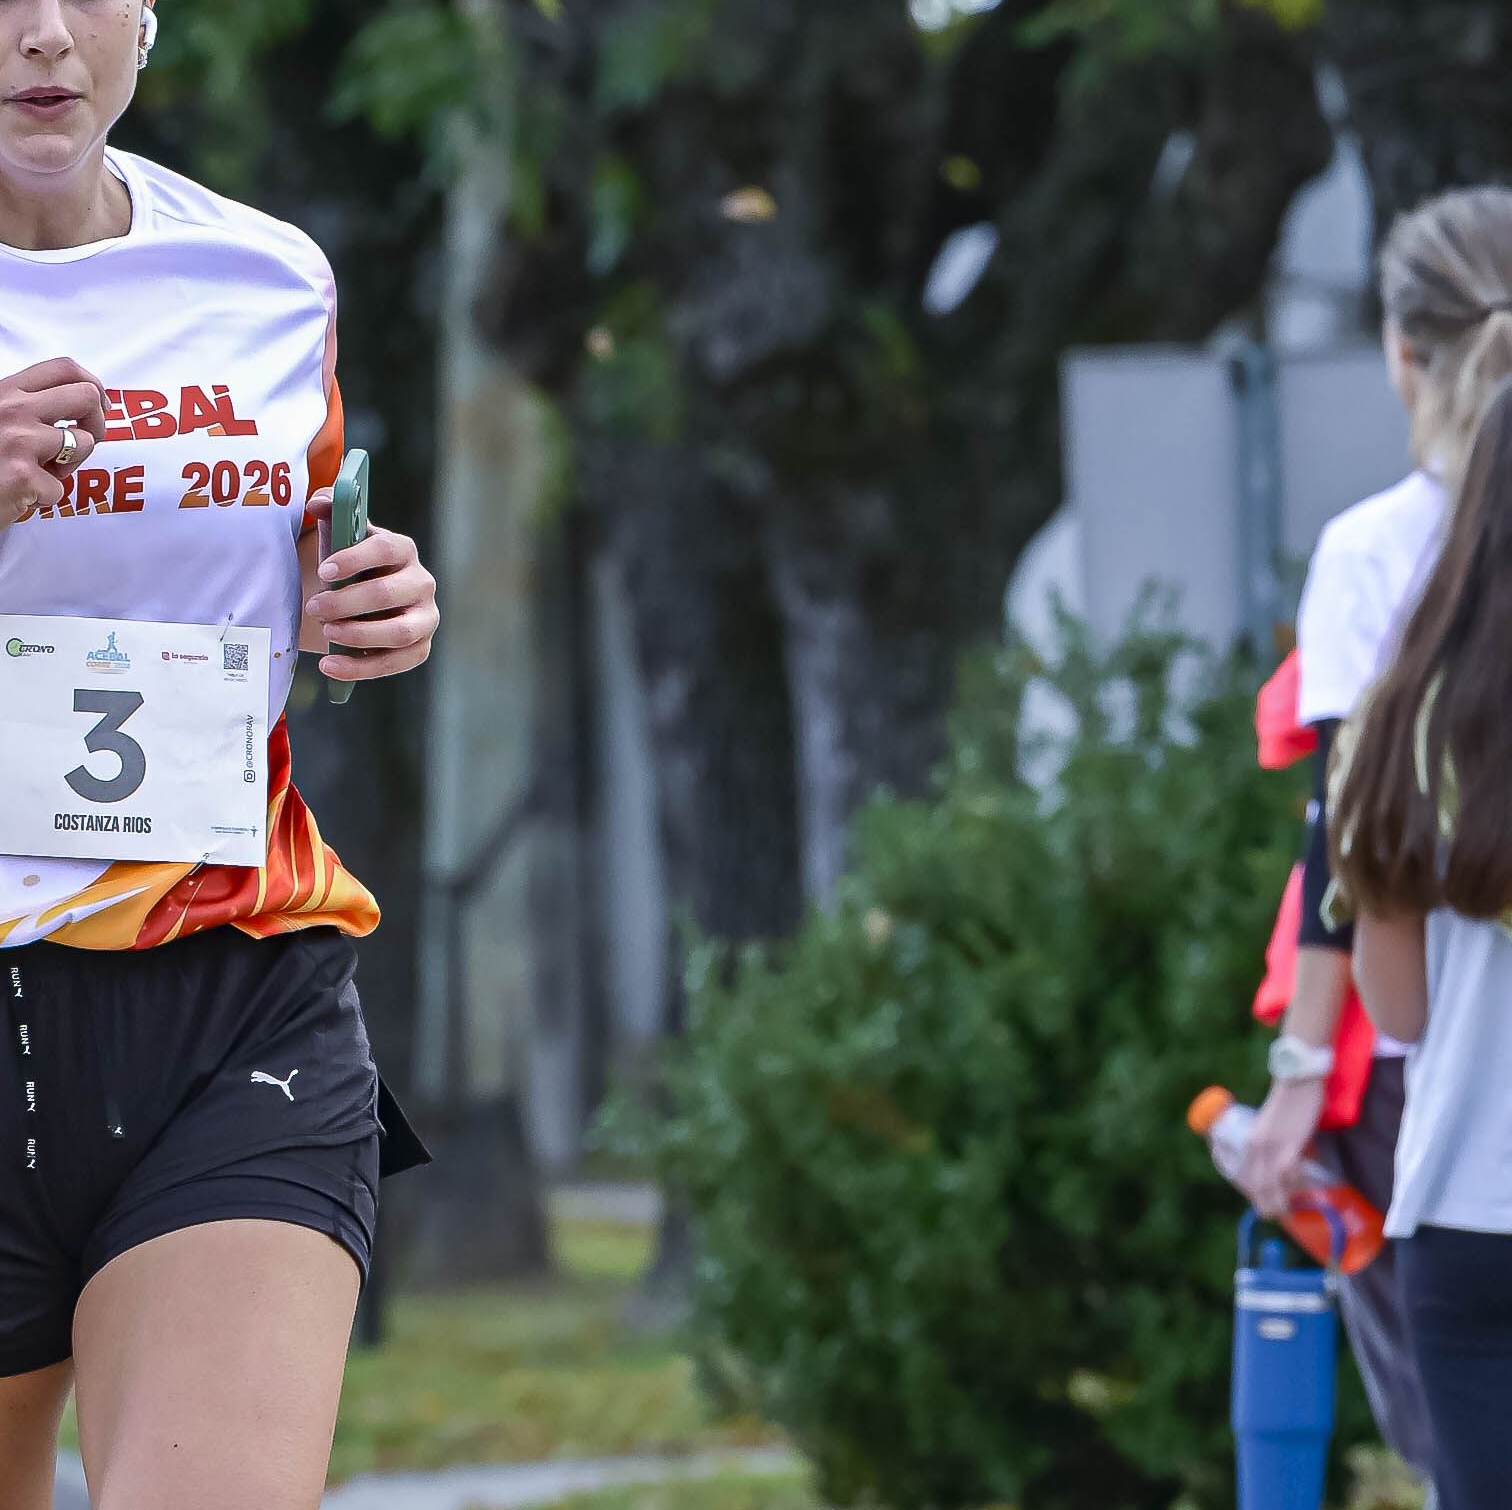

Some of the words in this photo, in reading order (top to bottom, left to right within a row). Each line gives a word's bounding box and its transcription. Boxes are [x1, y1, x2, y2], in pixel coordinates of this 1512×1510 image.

[13, 465, 145, 524] RRE
[178, 459, 292, 509] 2026
[64, 689, 146, 803] 3
[54, 813, 120, 833] COSTANZA
[122, 816, 152, 834] RIOS
[10, 967, 21, 988] RUN
[19, 1024, 29, 1045] RUN
[26, 1081, 35, 1102] RUN
[27, 1138, 36, 1158] RUN
